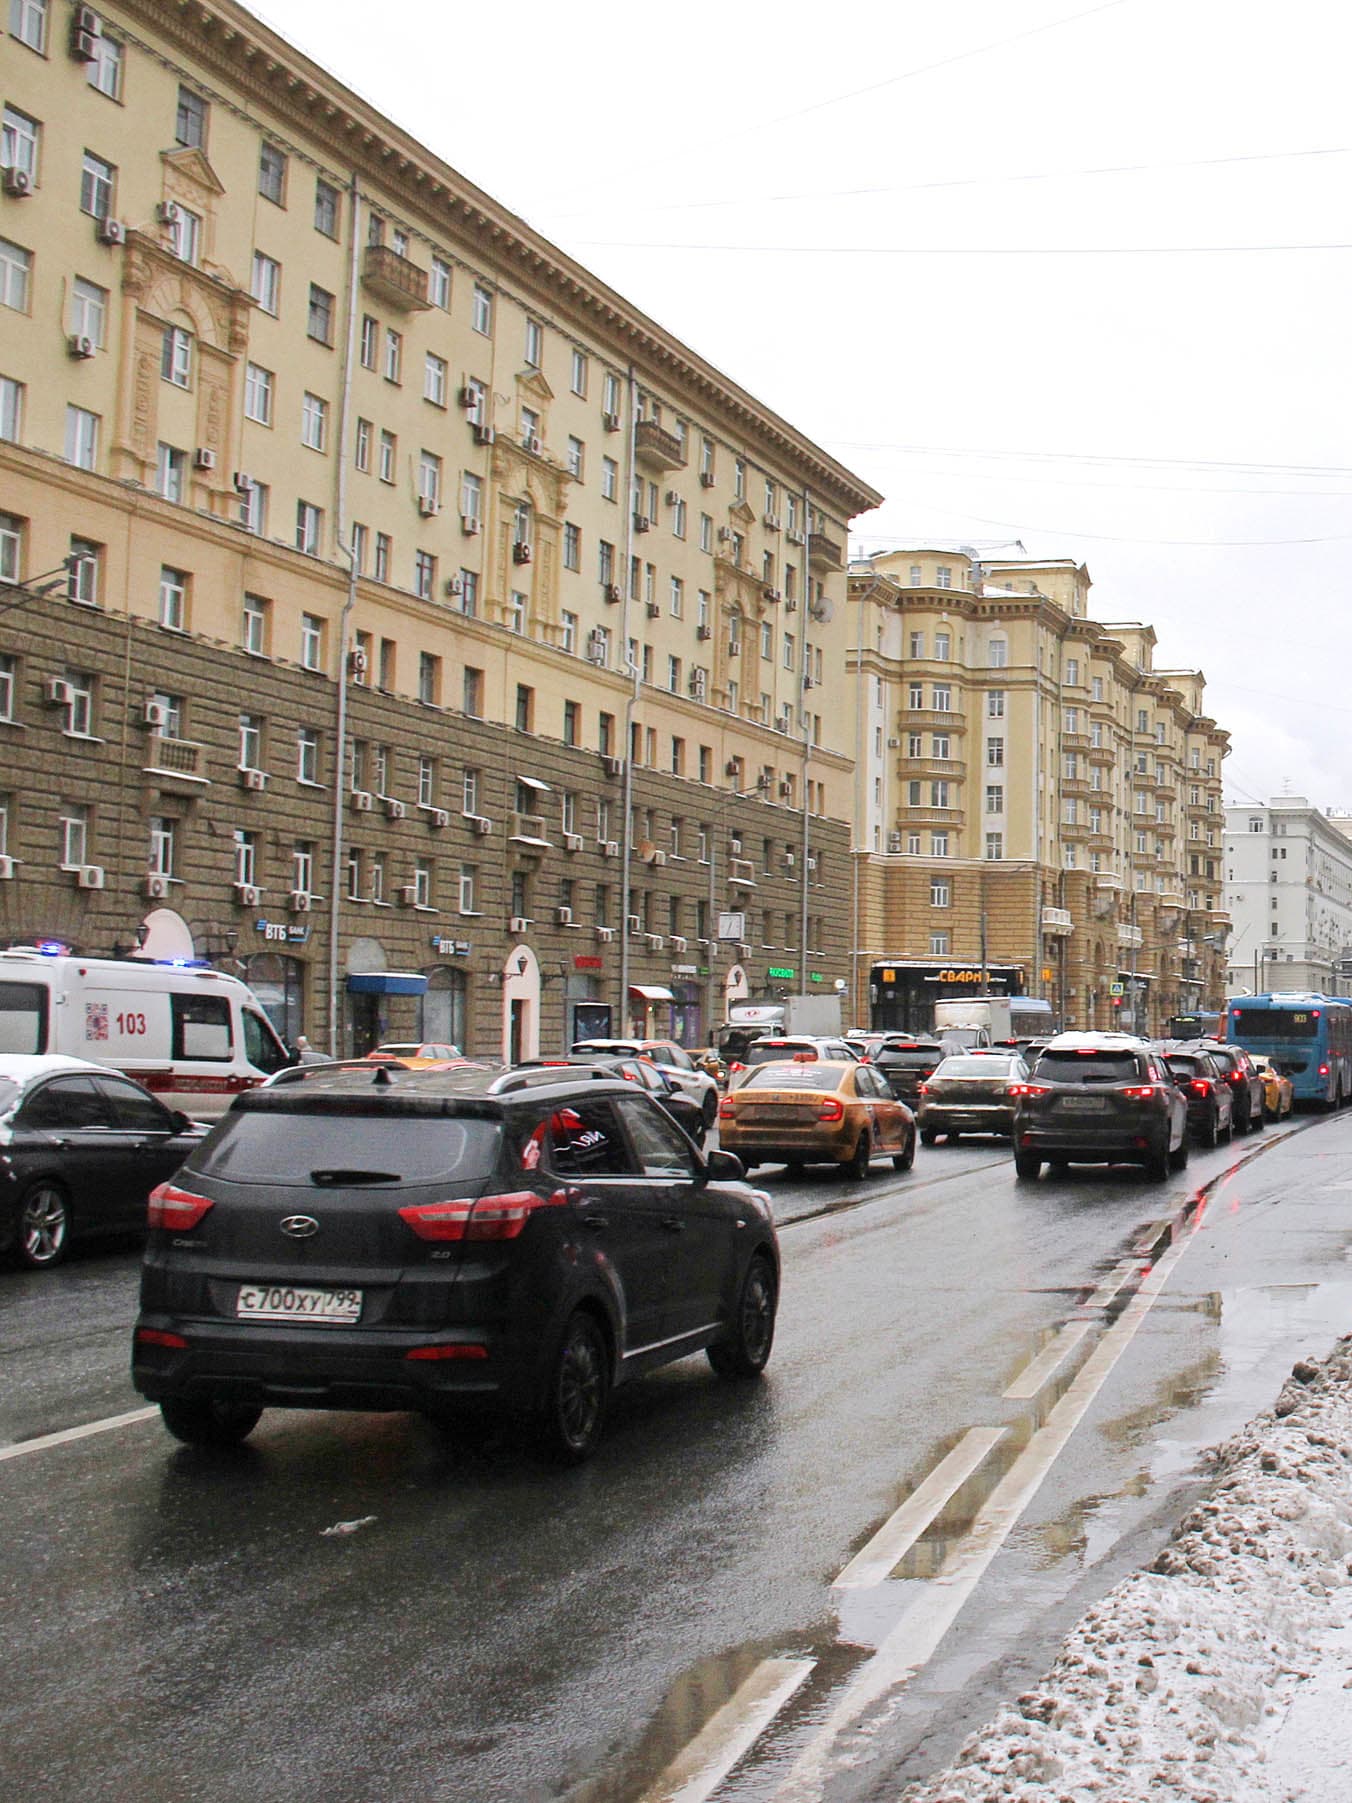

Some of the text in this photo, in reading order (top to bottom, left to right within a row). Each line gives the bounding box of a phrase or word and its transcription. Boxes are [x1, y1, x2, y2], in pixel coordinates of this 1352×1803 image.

[265, 924, 287, 940] ВТБ
[439, 940, 455, 954] ВТБ
[116, 1013, 146, 1035] 103
[327, 1290, 357, 1308] 799
